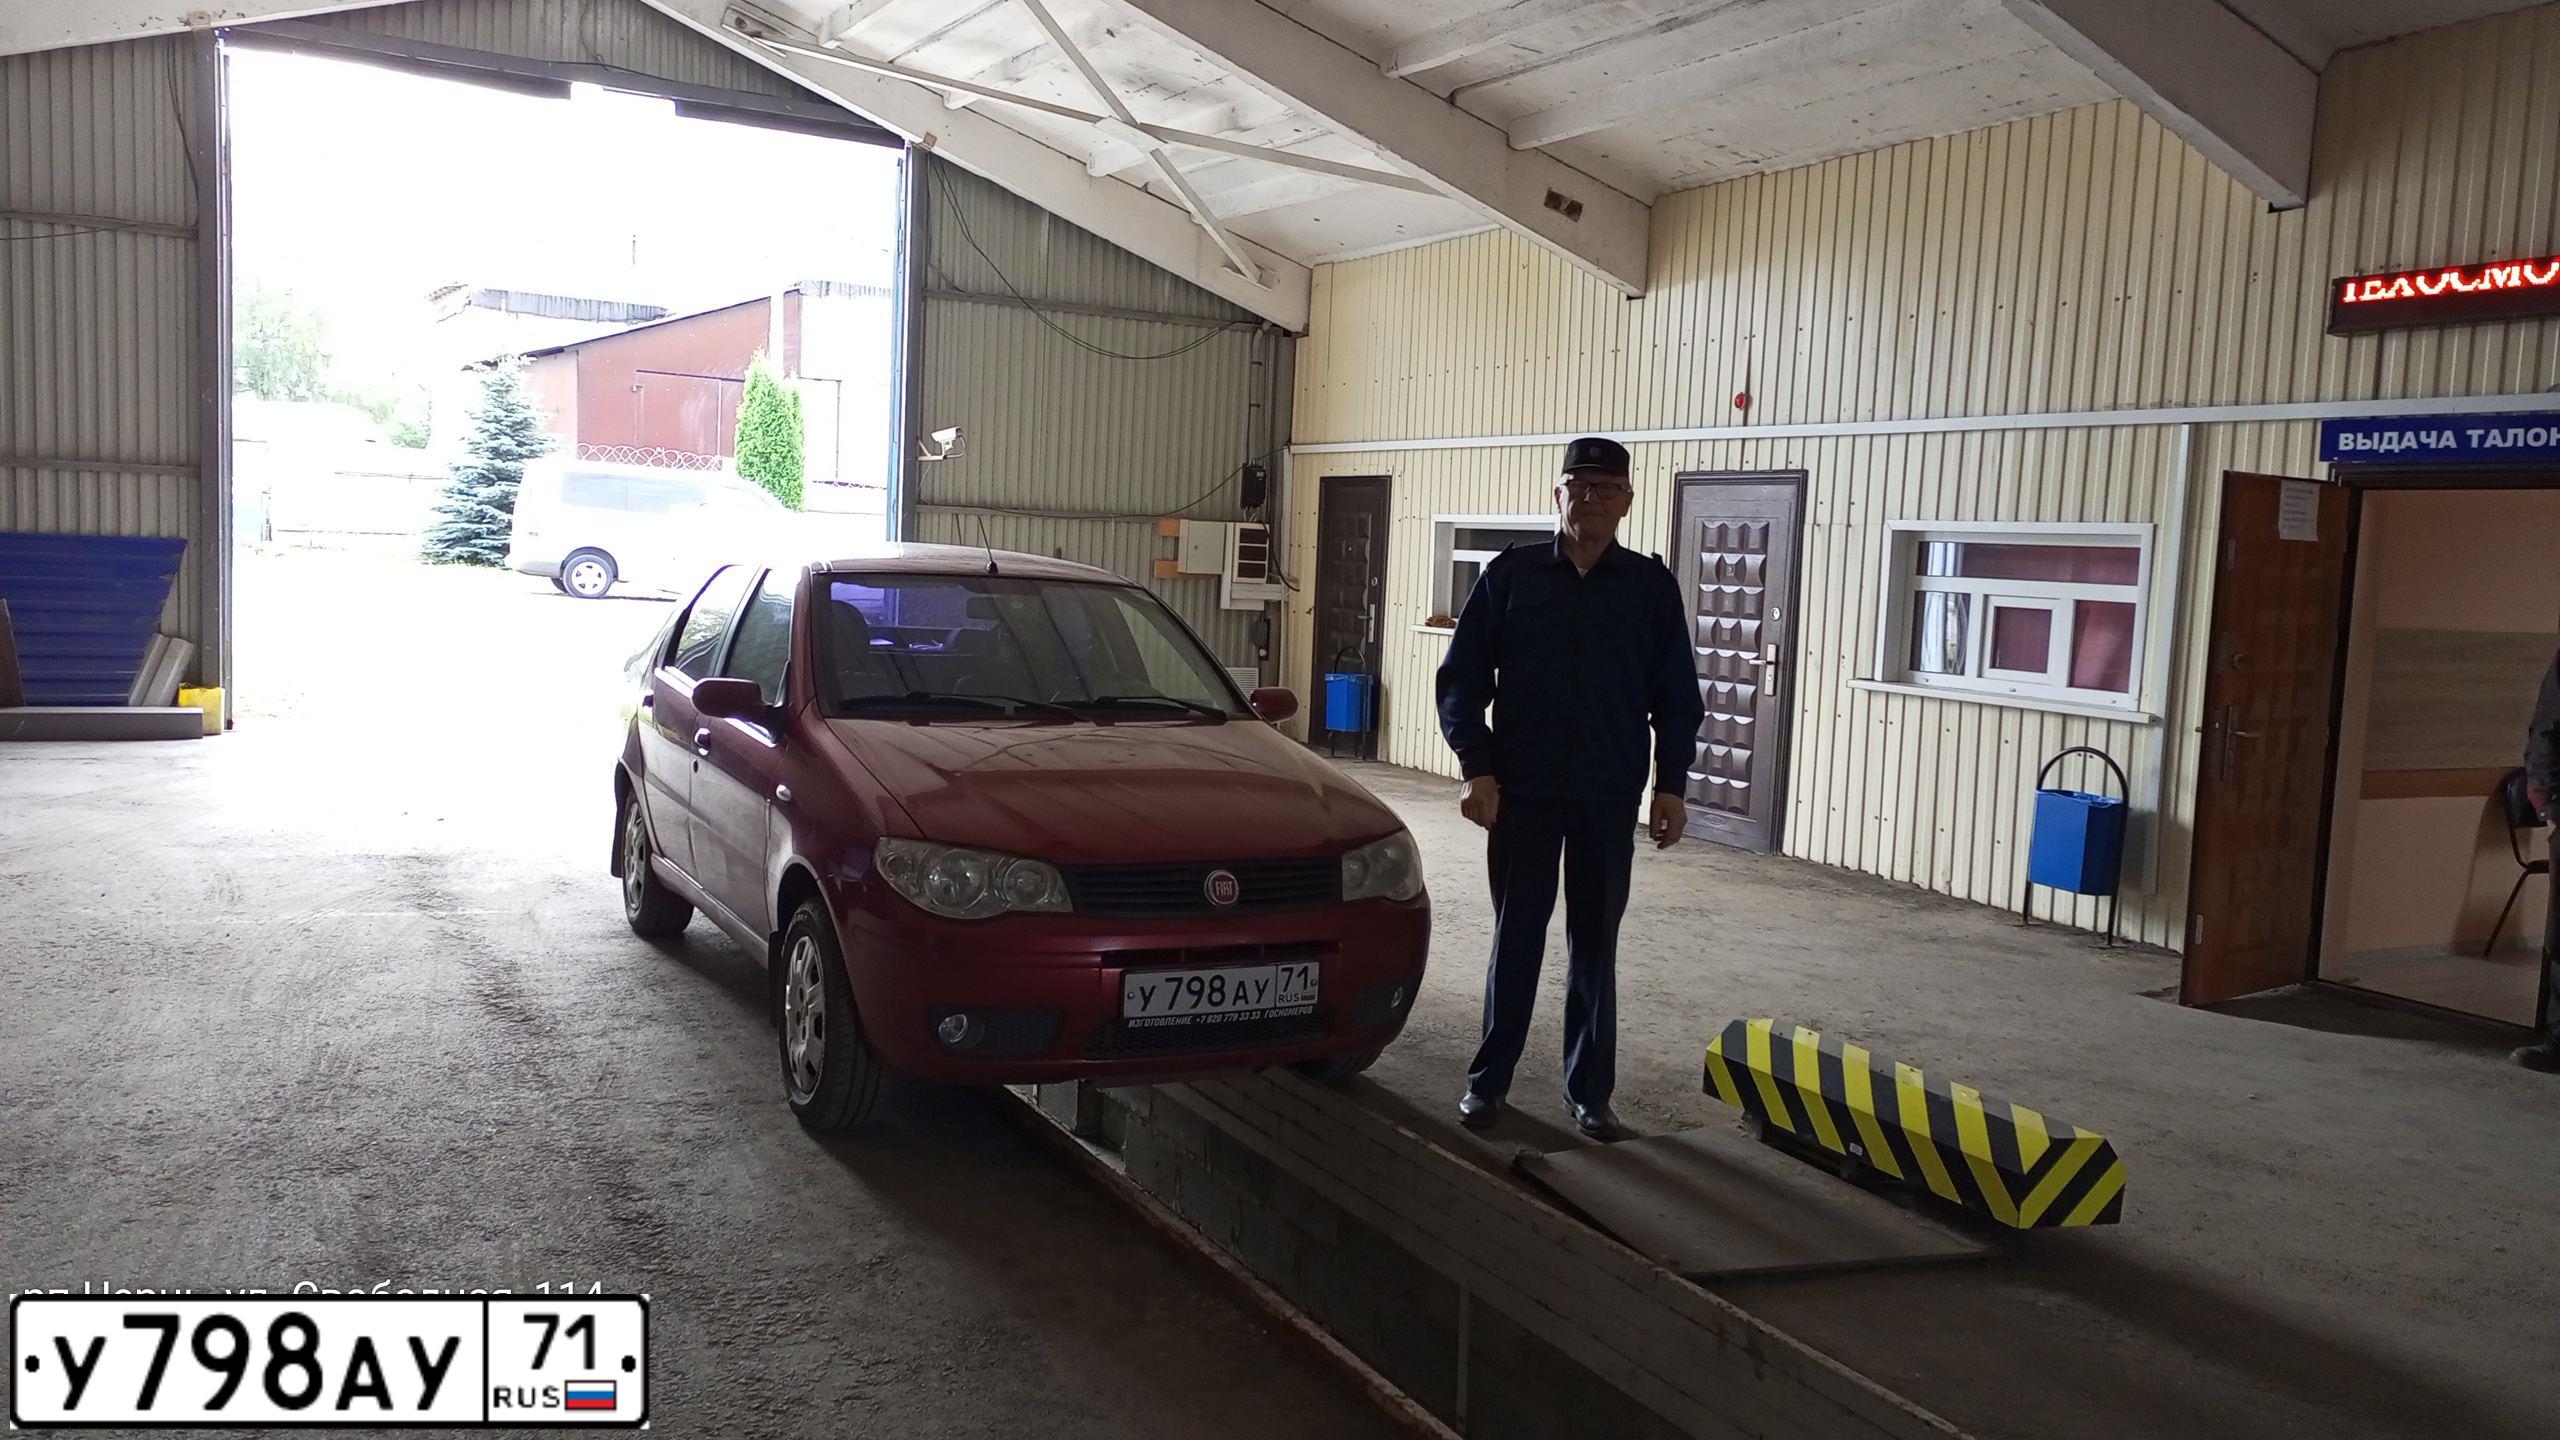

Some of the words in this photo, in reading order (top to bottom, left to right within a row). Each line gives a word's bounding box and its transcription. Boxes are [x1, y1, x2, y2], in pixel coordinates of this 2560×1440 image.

[2338, 430, 2457, 453] ВЫДАЧА
[1215, 881, 1233, 896] FIAT
[1281, 965, 1308, 992] 71
[1278, 992, 1300, 1004] RUS
[1128, 1015, 1193, 1028] ИЗГОТОВЛЕНИЕ
[1264, 1005, 1313, 1019] ГОСНОМЕРОВ
